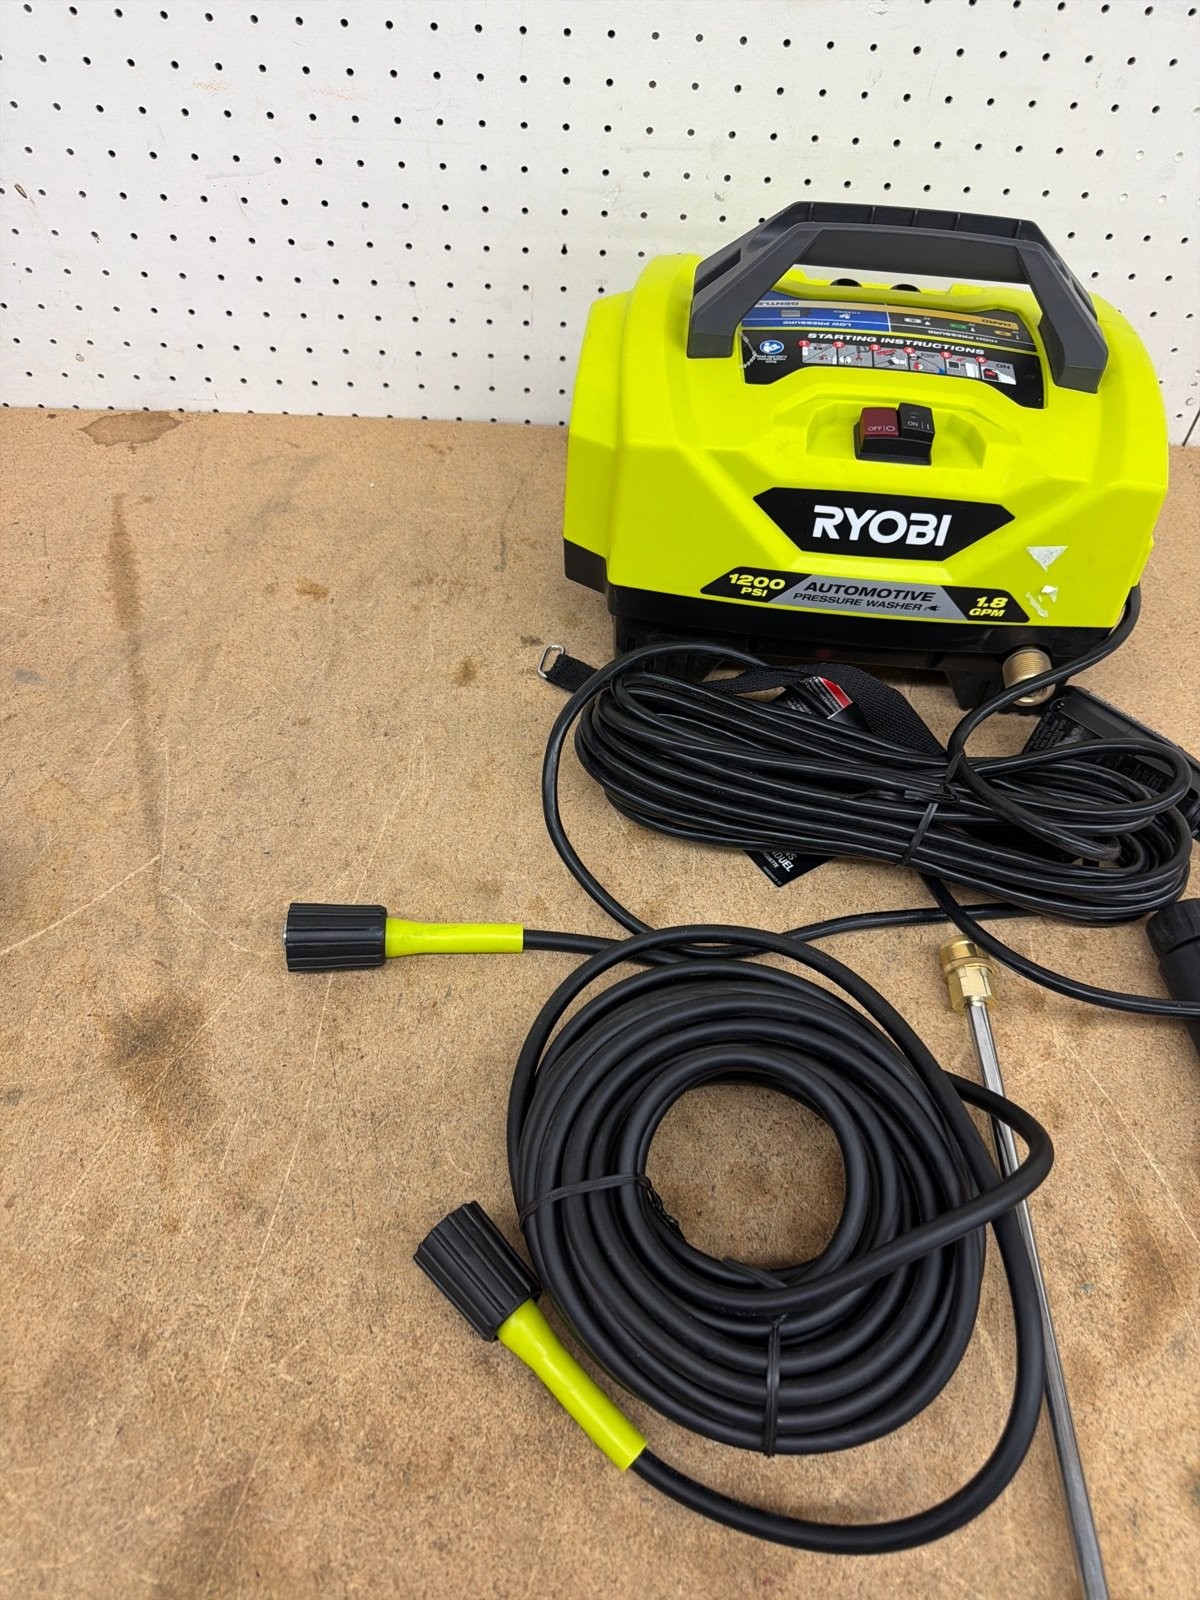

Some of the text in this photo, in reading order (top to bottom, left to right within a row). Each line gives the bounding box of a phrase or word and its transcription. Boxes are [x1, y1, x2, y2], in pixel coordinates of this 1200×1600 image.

[980, 318, 1012, 327] HARD
[928, 329, 975, 340] PRESSURE
[807, 333, 877, 343] STARTING
[880, 338, 985, 355] INSTRUCTIONS
[812, 504, 952, 546] RYOBI
[729, 573, 786, 590] 1200
[740, 587, 768, 597] PSI
[804, 582, 937, 602] AUTOMOTIVE
[793, 592, 923, 611] PRESSURE WASHER
[976, 596, 1008, 608] 1.8
[968, 608, 1006, 617] GPM
